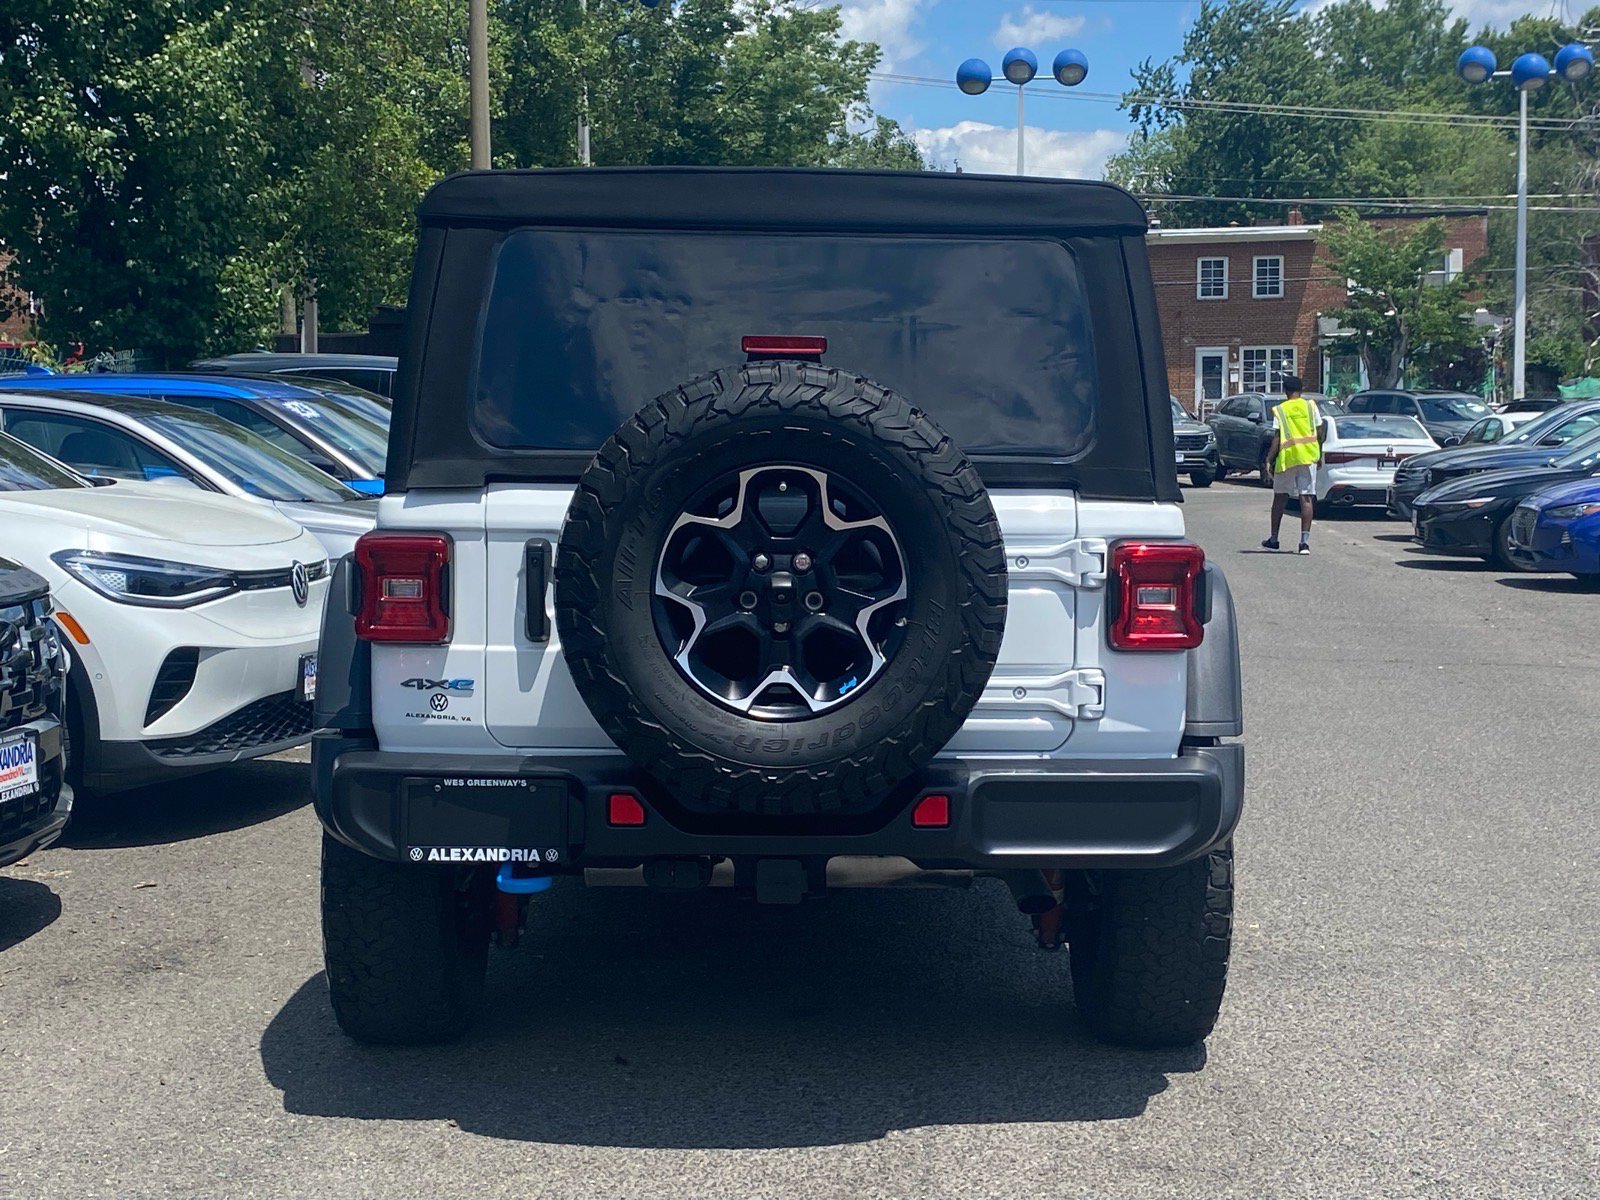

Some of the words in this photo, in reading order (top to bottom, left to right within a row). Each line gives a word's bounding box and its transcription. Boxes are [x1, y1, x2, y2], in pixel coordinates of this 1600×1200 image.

[405, 712, 459, 722] ALEXANDRIA,
[443, 778, 465, 787] WES
[467, 778, 527, 787] GREENWAY'S
[428, 848, 541, 862] ALEXANDRIA
